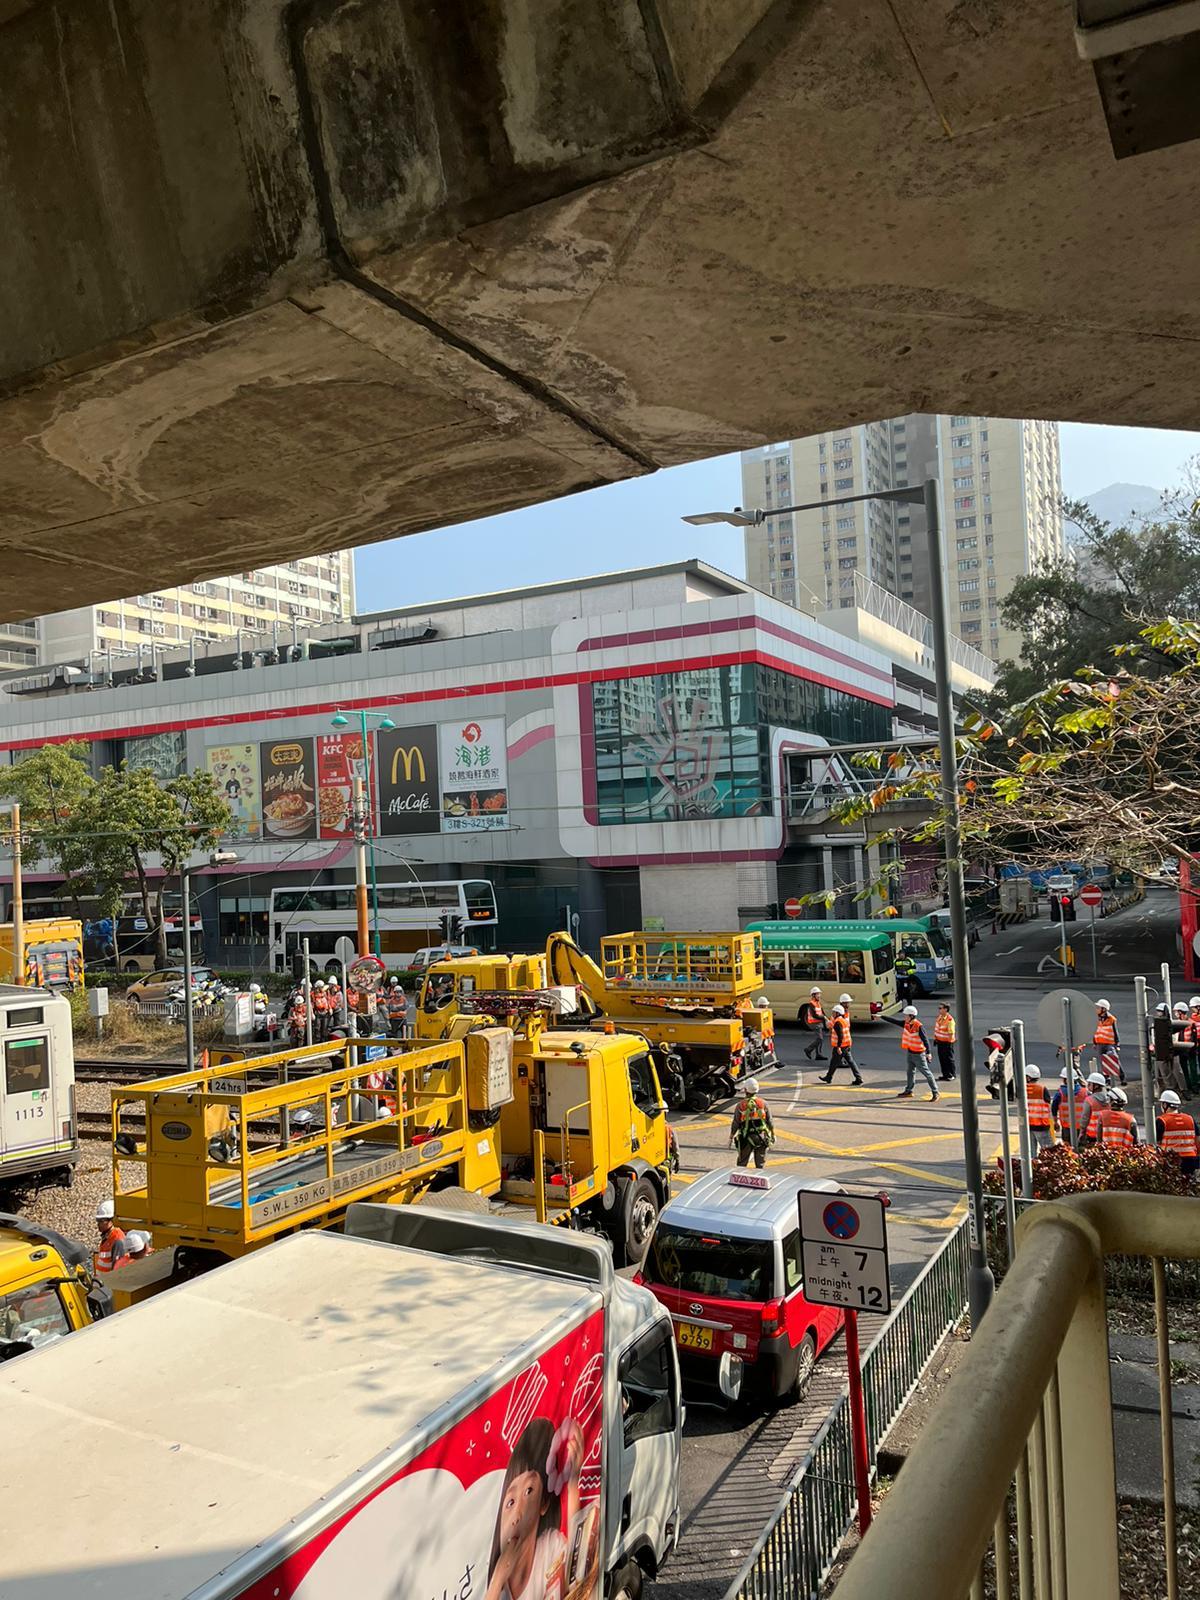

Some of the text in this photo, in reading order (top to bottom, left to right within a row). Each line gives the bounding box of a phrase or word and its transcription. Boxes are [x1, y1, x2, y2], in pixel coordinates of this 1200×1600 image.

[322, 744, 344, 755] KFC
[455, 744, 492, 768] 海港
[15, 1106, 44, 1121] 1113
[732, 1174, 766, 1187] TAXI
[293, 1191, 309, 1205] 350
[312, 1185, 326, 1198] KG
[820, 1244, 836, 1255] am
[817, 1255, 841, 1268] 上午
[854, 1251, 869, 1272] 7
[808, 1275, 852, 1291] midnight
[819, 1287, 843, 1302] 午夜
[857, 1285, 883, 1308] 12
